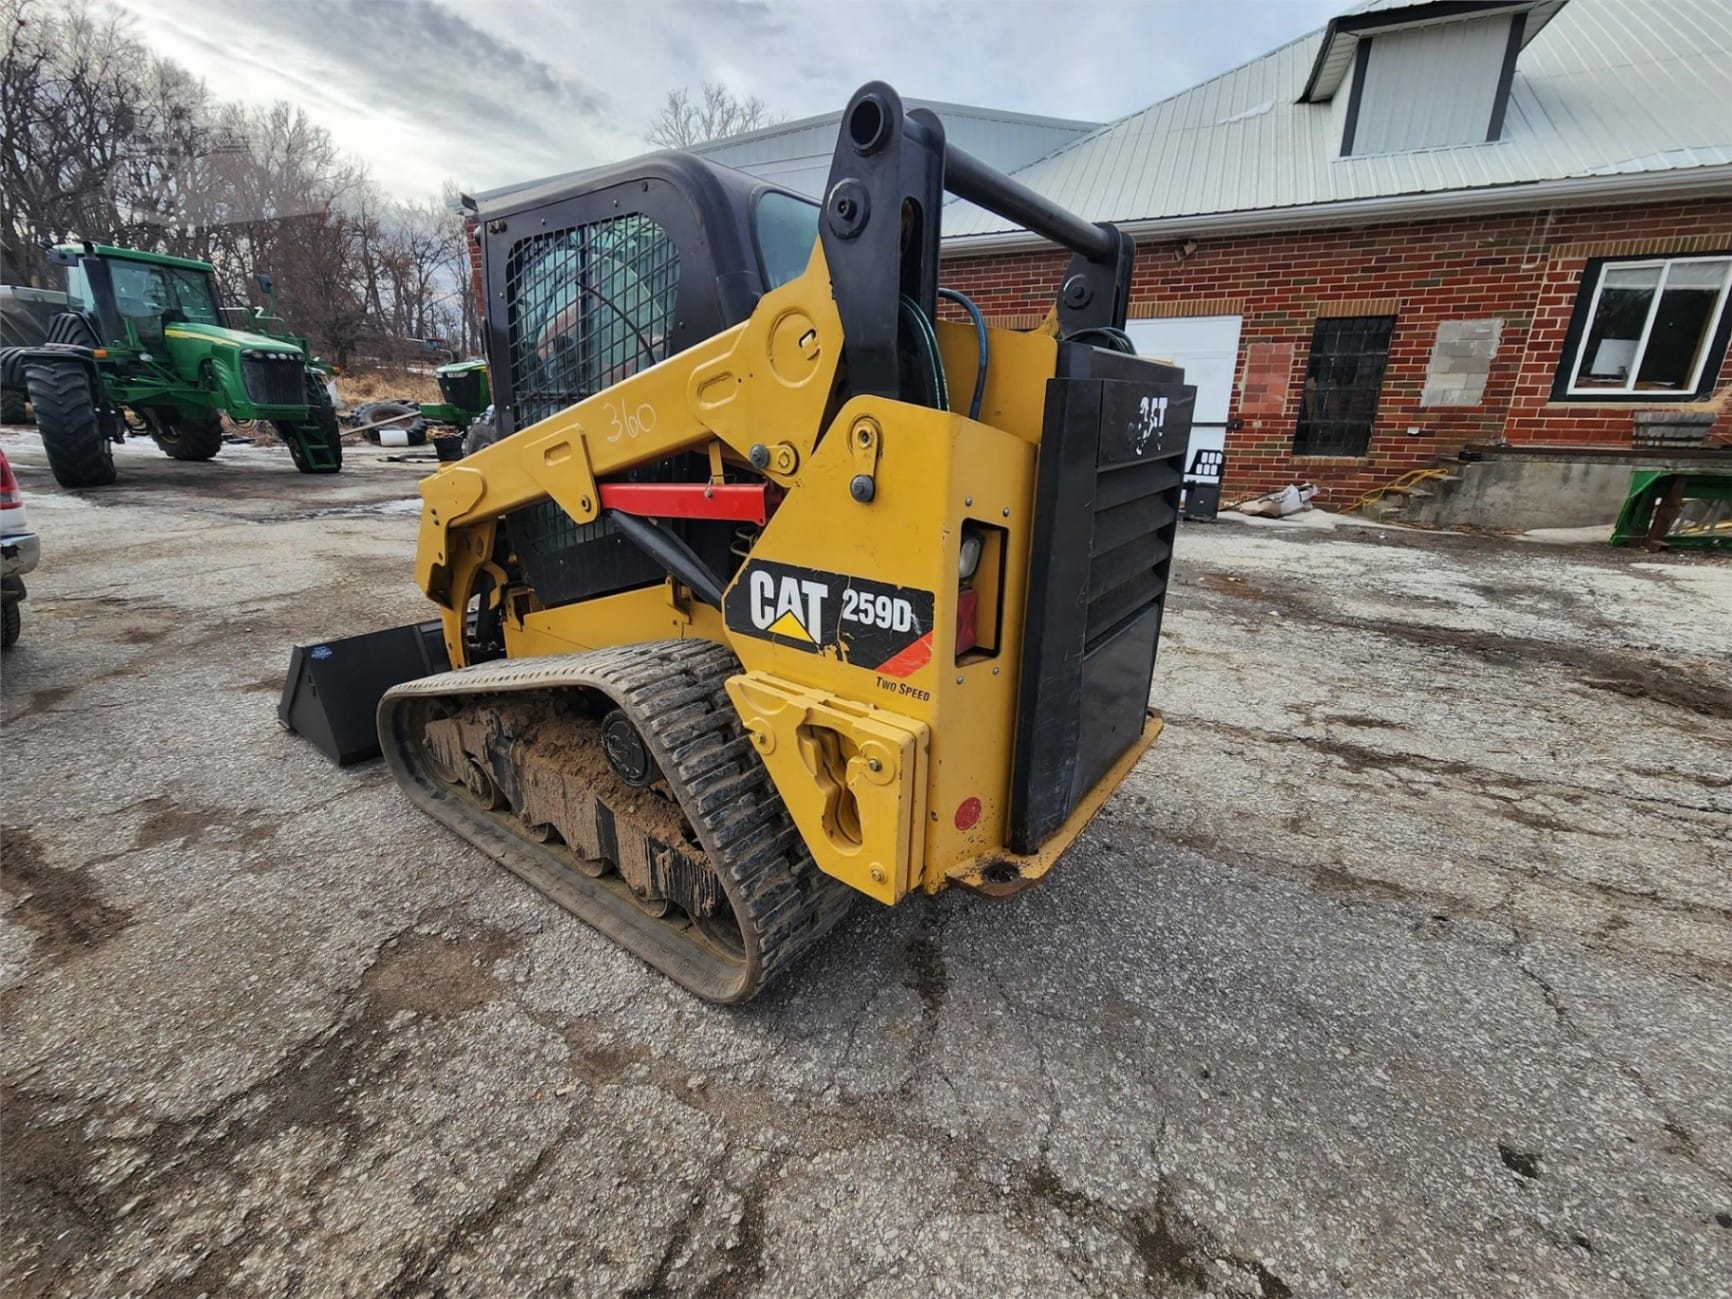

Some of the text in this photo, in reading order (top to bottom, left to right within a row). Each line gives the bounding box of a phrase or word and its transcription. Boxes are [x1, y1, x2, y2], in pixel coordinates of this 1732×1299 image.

[602, 397, 656, 442] 360
[750, 570, 912, 645] CAT 259D
